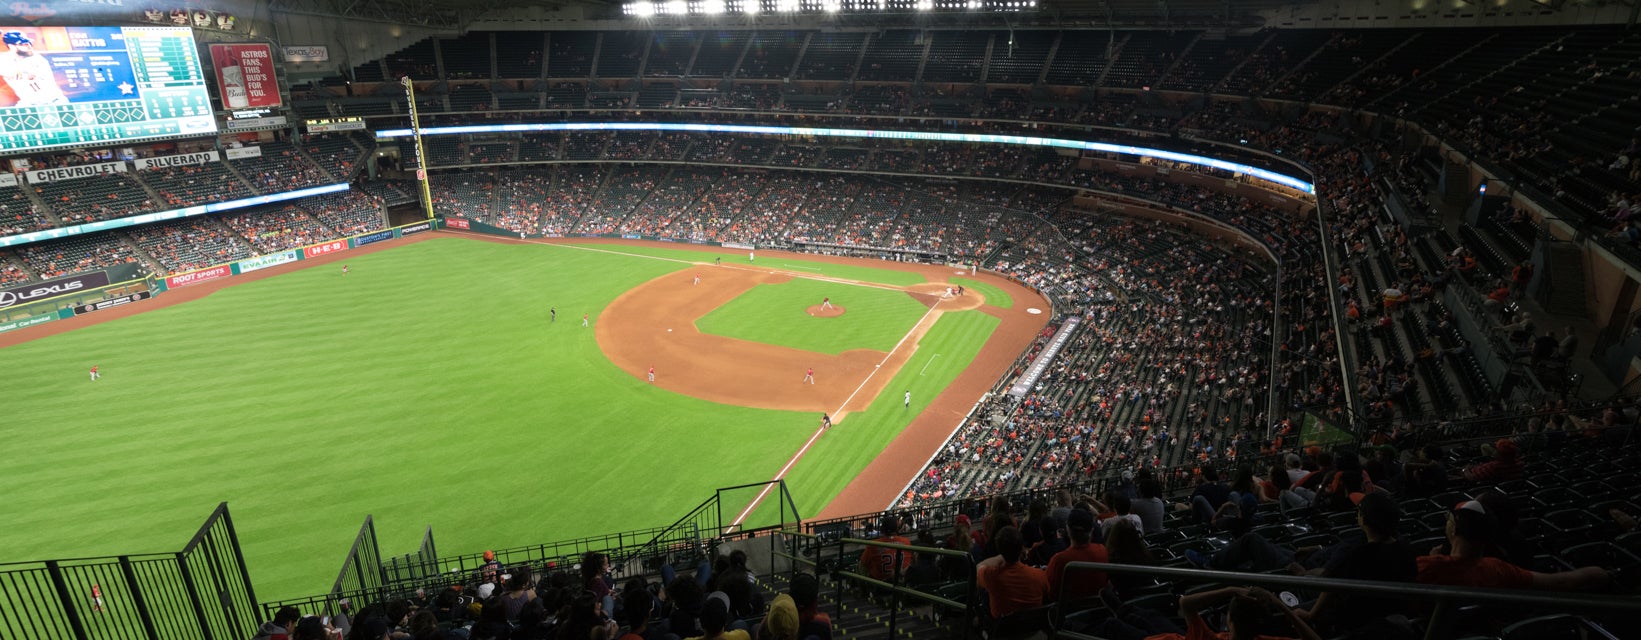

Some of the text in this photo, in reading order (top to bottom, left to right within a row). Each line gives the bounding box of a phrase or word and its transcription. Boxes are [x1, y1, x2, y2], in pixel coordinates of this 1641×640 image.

[241, 50, 268, 58] ASTROS
[242, 59, 263, 67] FANS,
[244, 66, 261, 74] THIS
[246, 73, 267, 81] BUD'S
[249, 89, 266, 97] YOU.
[145, 153, 211, 168] SILVERADO
[37, 163, 117, 181] CHEVROLET
[172, 272, 195, 284] ROOT
[197, 267, 225, 279] SPORTS
[18, 280, 83, 300] LEXUS
